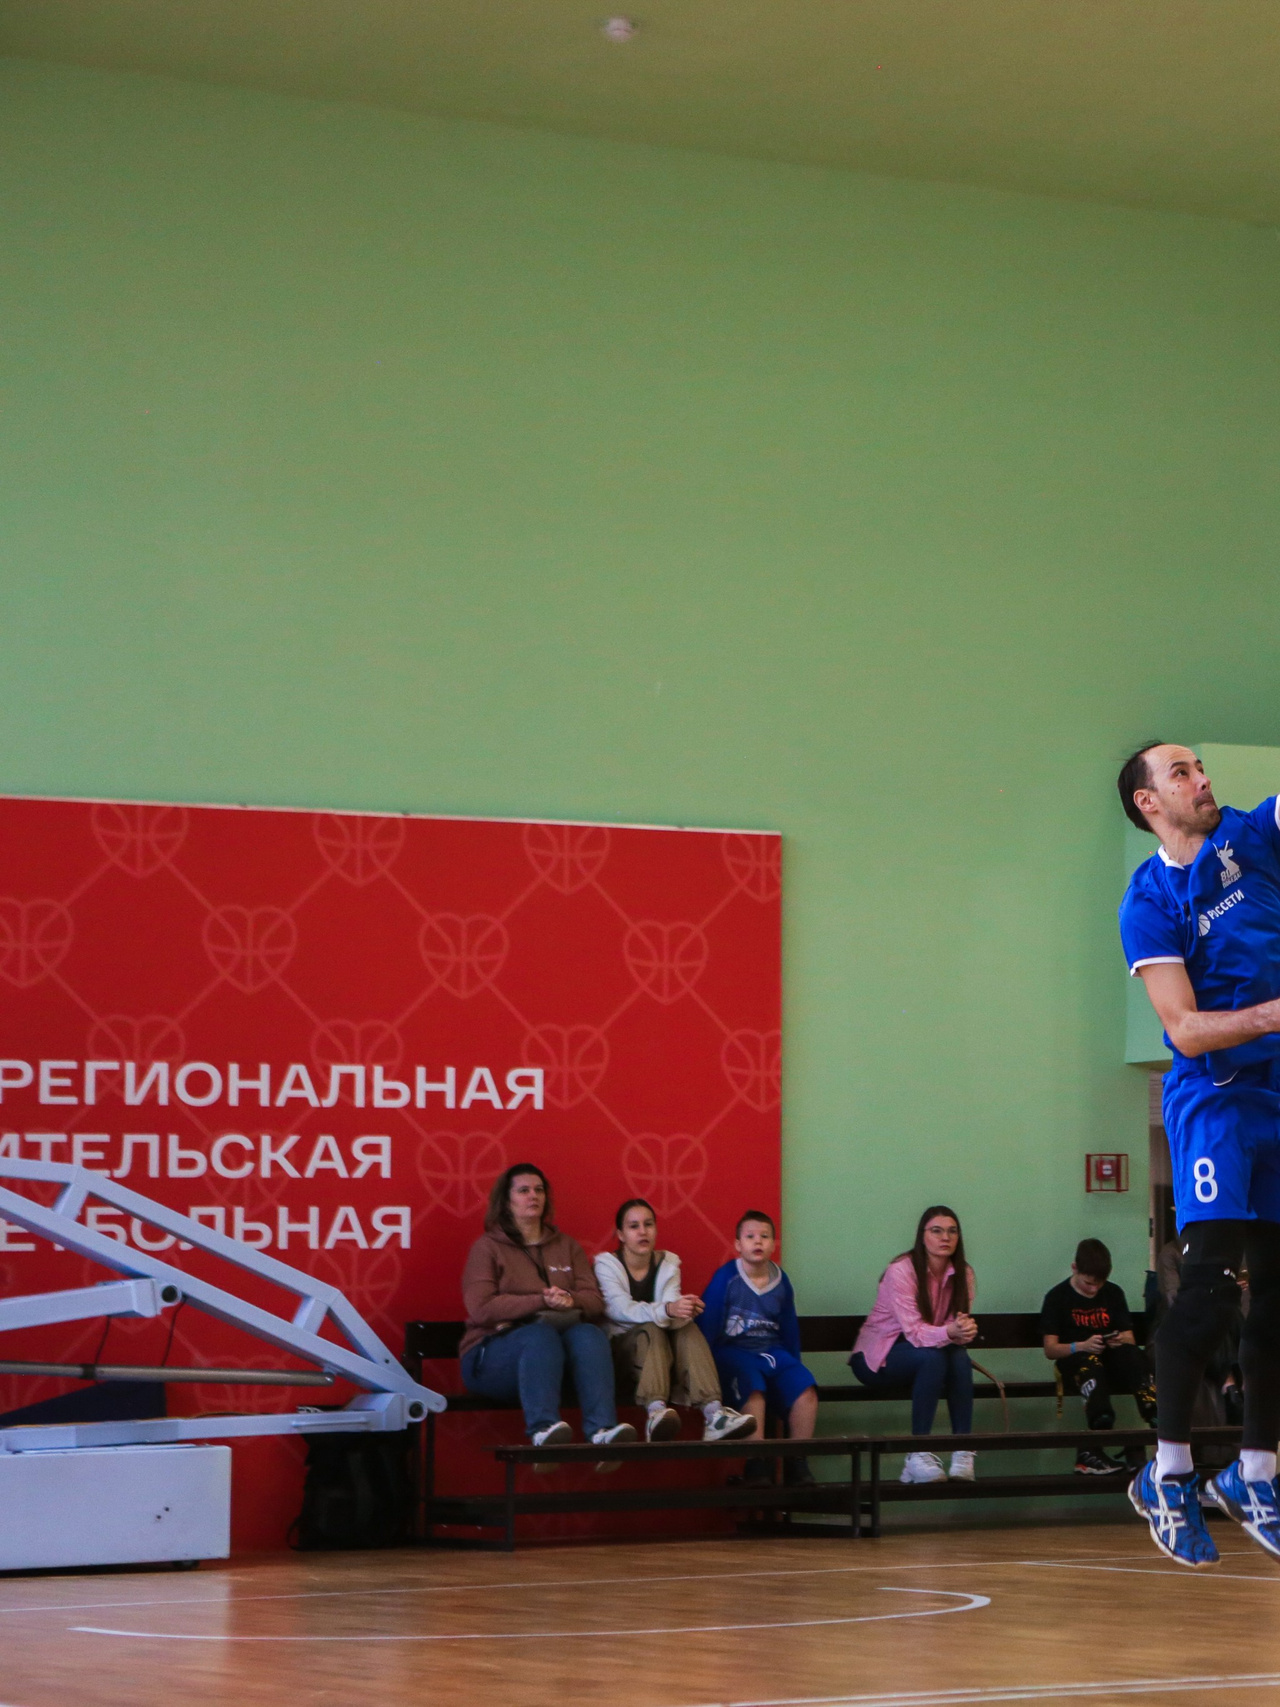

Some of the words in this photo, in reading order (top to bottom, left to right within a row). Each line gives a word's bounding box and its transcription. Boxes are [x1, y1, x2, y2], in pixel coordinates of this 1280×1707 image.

[0, 1059, 544, 1110] РЕГИОНАЛЬНАЯ
[0, 1132, 392, 1179] ТЕЛЬСКАЯ
[1193, 1157, 1219, 1203] 8
[0, 1206, 411, 1251] ЕБОЛЬНАЯ
